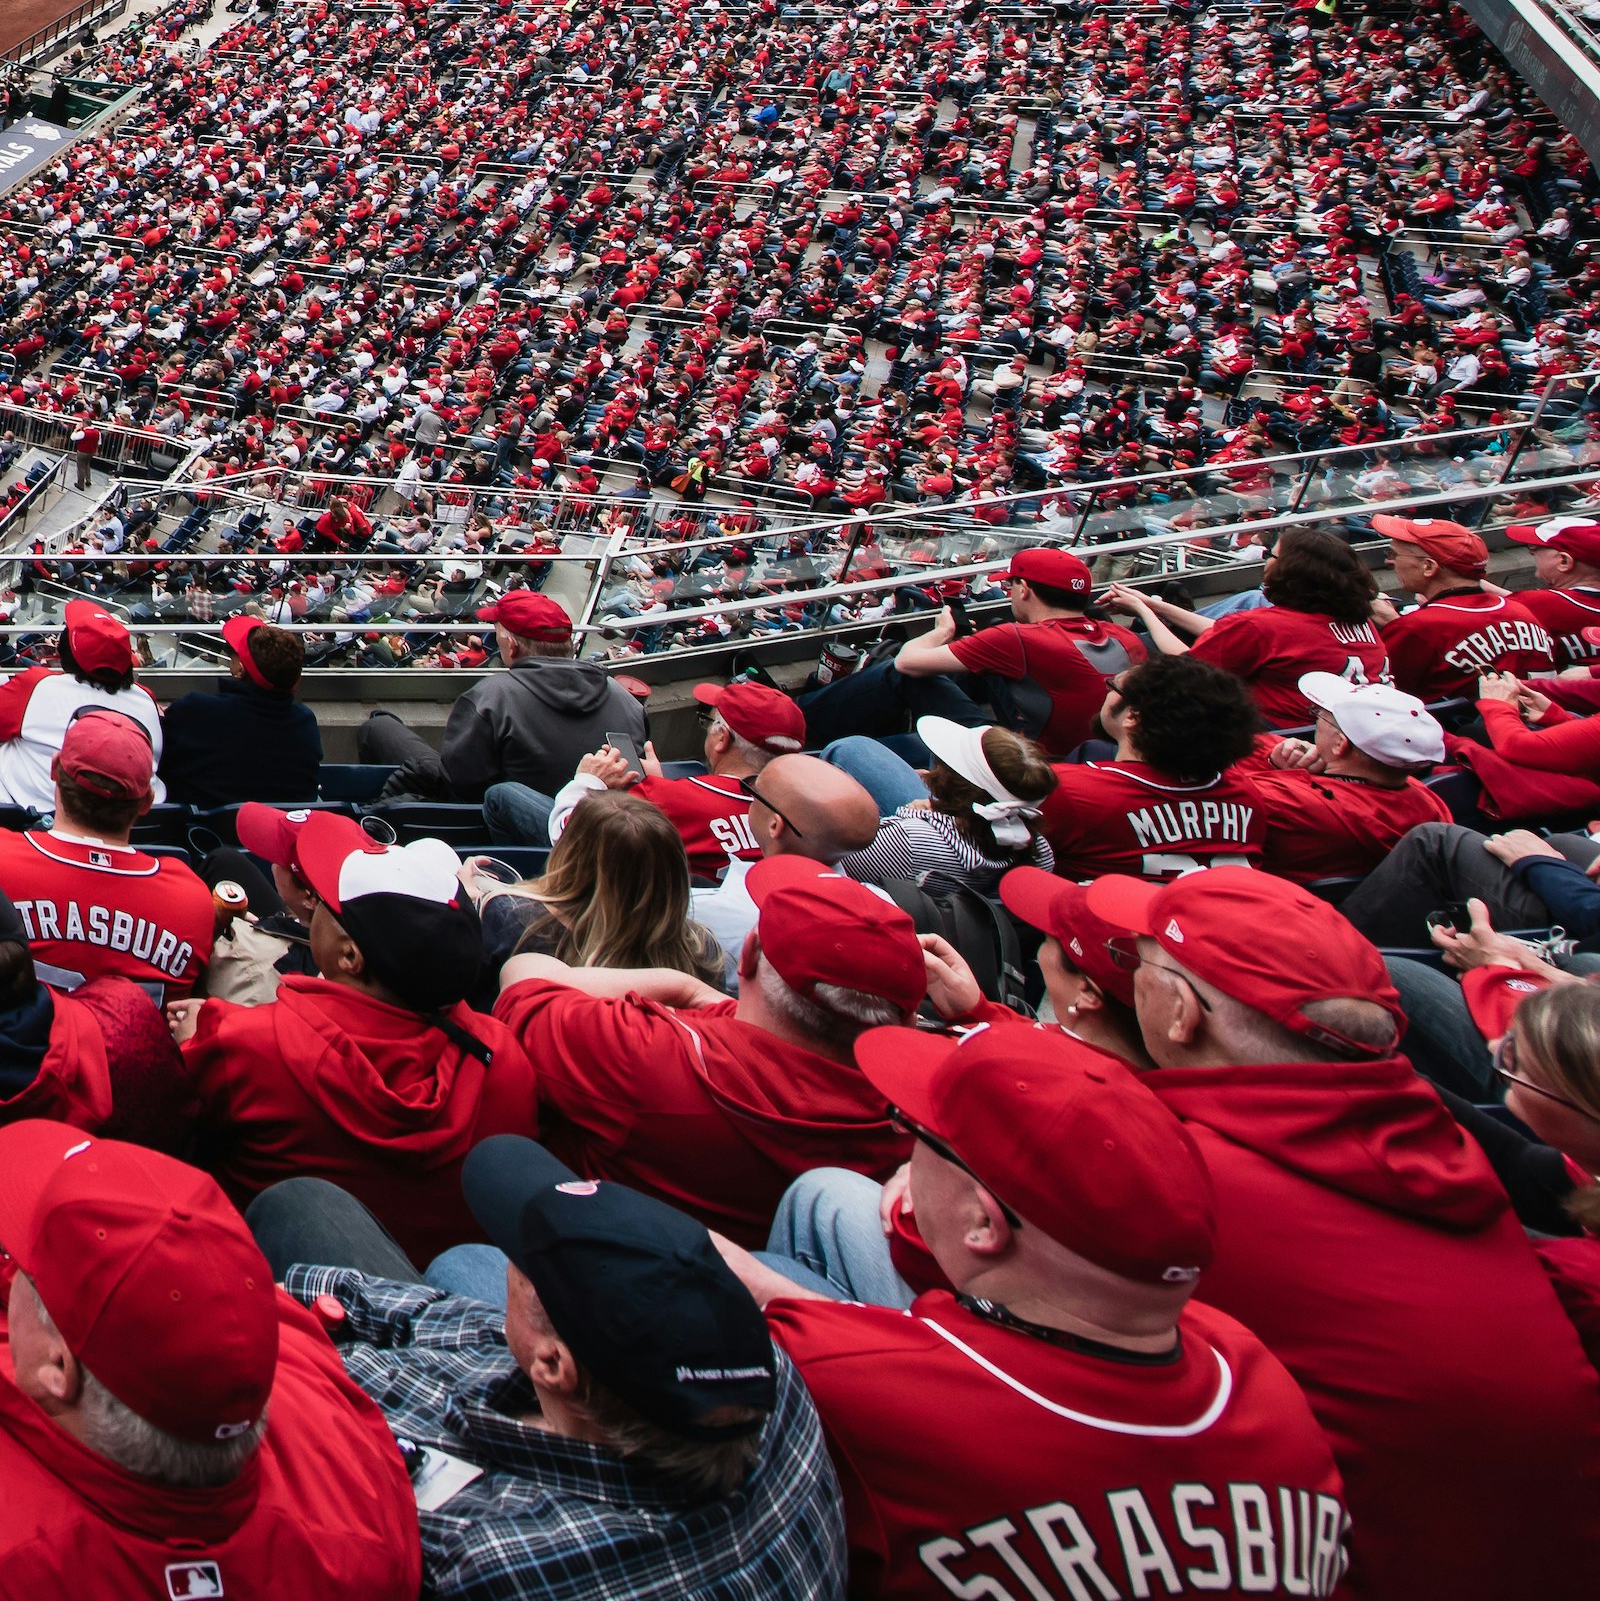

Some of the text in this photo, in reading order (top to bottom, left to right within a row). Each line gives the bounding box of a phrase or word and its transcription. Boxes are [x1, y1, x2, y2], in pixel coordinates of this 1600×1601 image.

[1328, 621, 1377, 645] DUNN
[1126, 800, 1253, 849] MURPHY
[12, 899, 192, 978] TRASBURG
[918, 1481, 1352, 1601] STRASBUR
